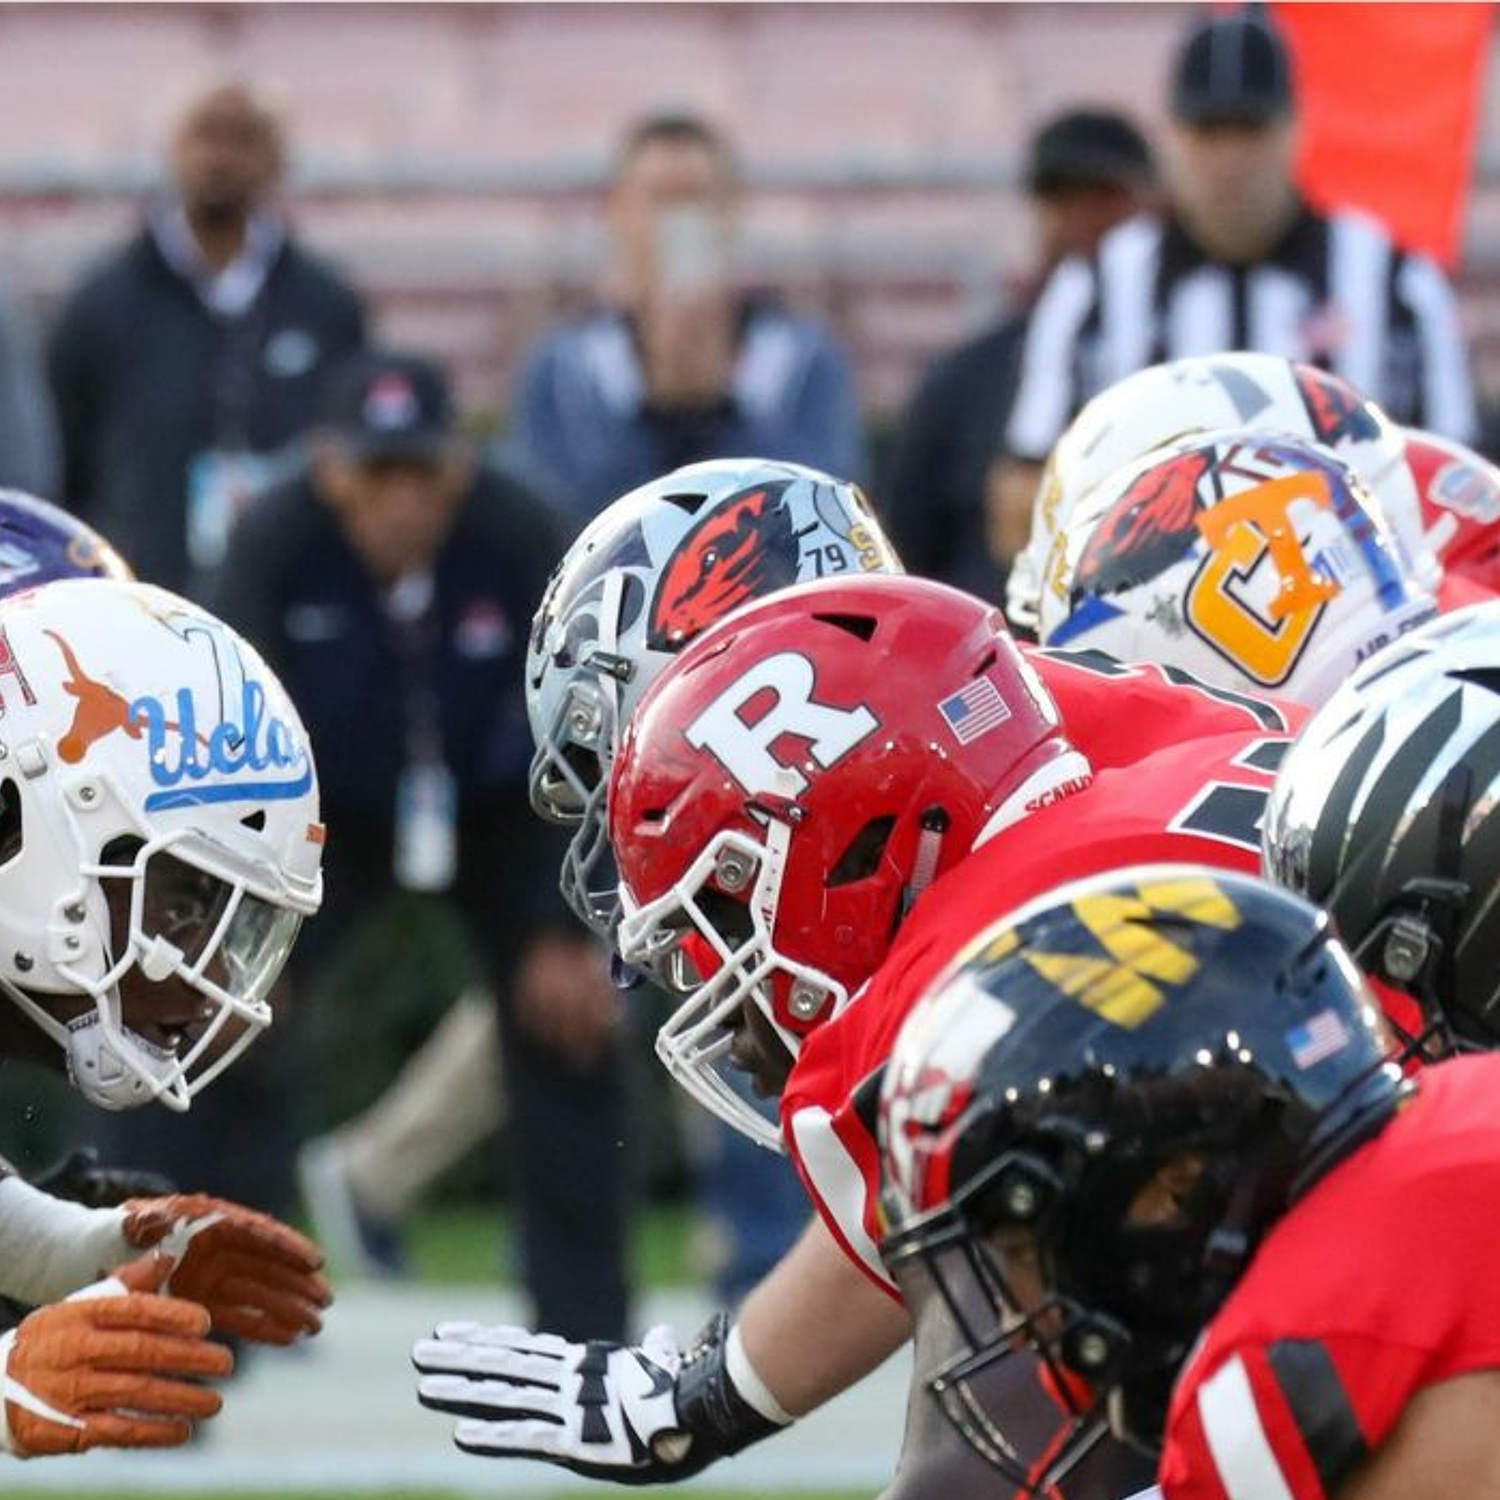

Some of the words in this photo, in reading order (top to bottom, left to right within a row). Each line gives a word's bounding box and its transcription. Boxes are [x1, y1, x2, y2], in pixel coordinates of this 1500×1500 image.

[805, 543, 848, 577] 79
[1194, 468, 1343, 622] T
[681, 651, 883, 801] R
